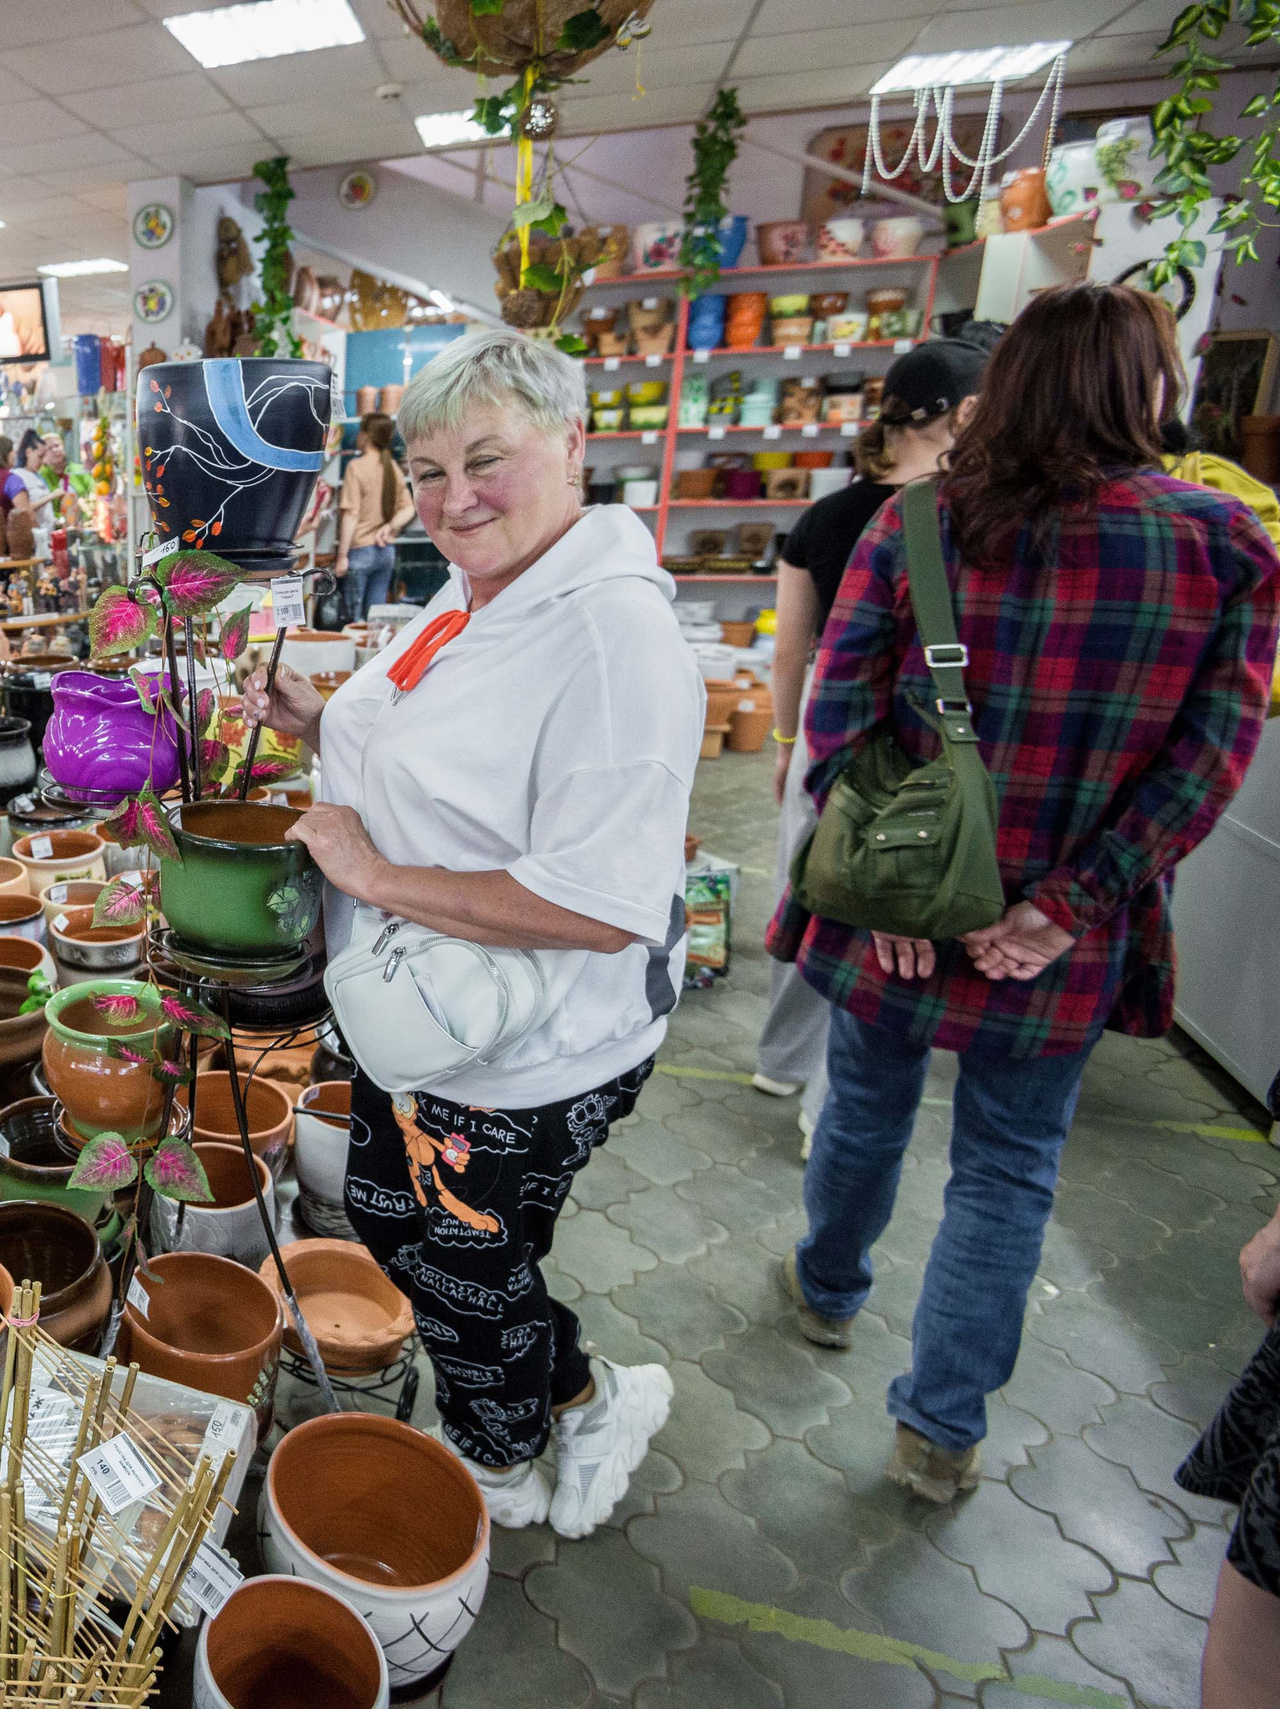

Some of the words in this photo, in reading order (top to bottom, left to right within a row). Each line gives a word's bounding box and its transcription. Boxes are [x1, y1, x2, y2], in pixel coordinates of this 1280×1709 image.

[431, 1104, 450, 1121] ME
[453, 1114, 465, 1127] IF
[470, 1120, 477, 1132] I
[482, 1123, 516, 1144] CARE
[443, 1423, 461, 1440] ME
[460, 1437, 473, 1449] IF
[96, 1458, 110, 1475] 140
